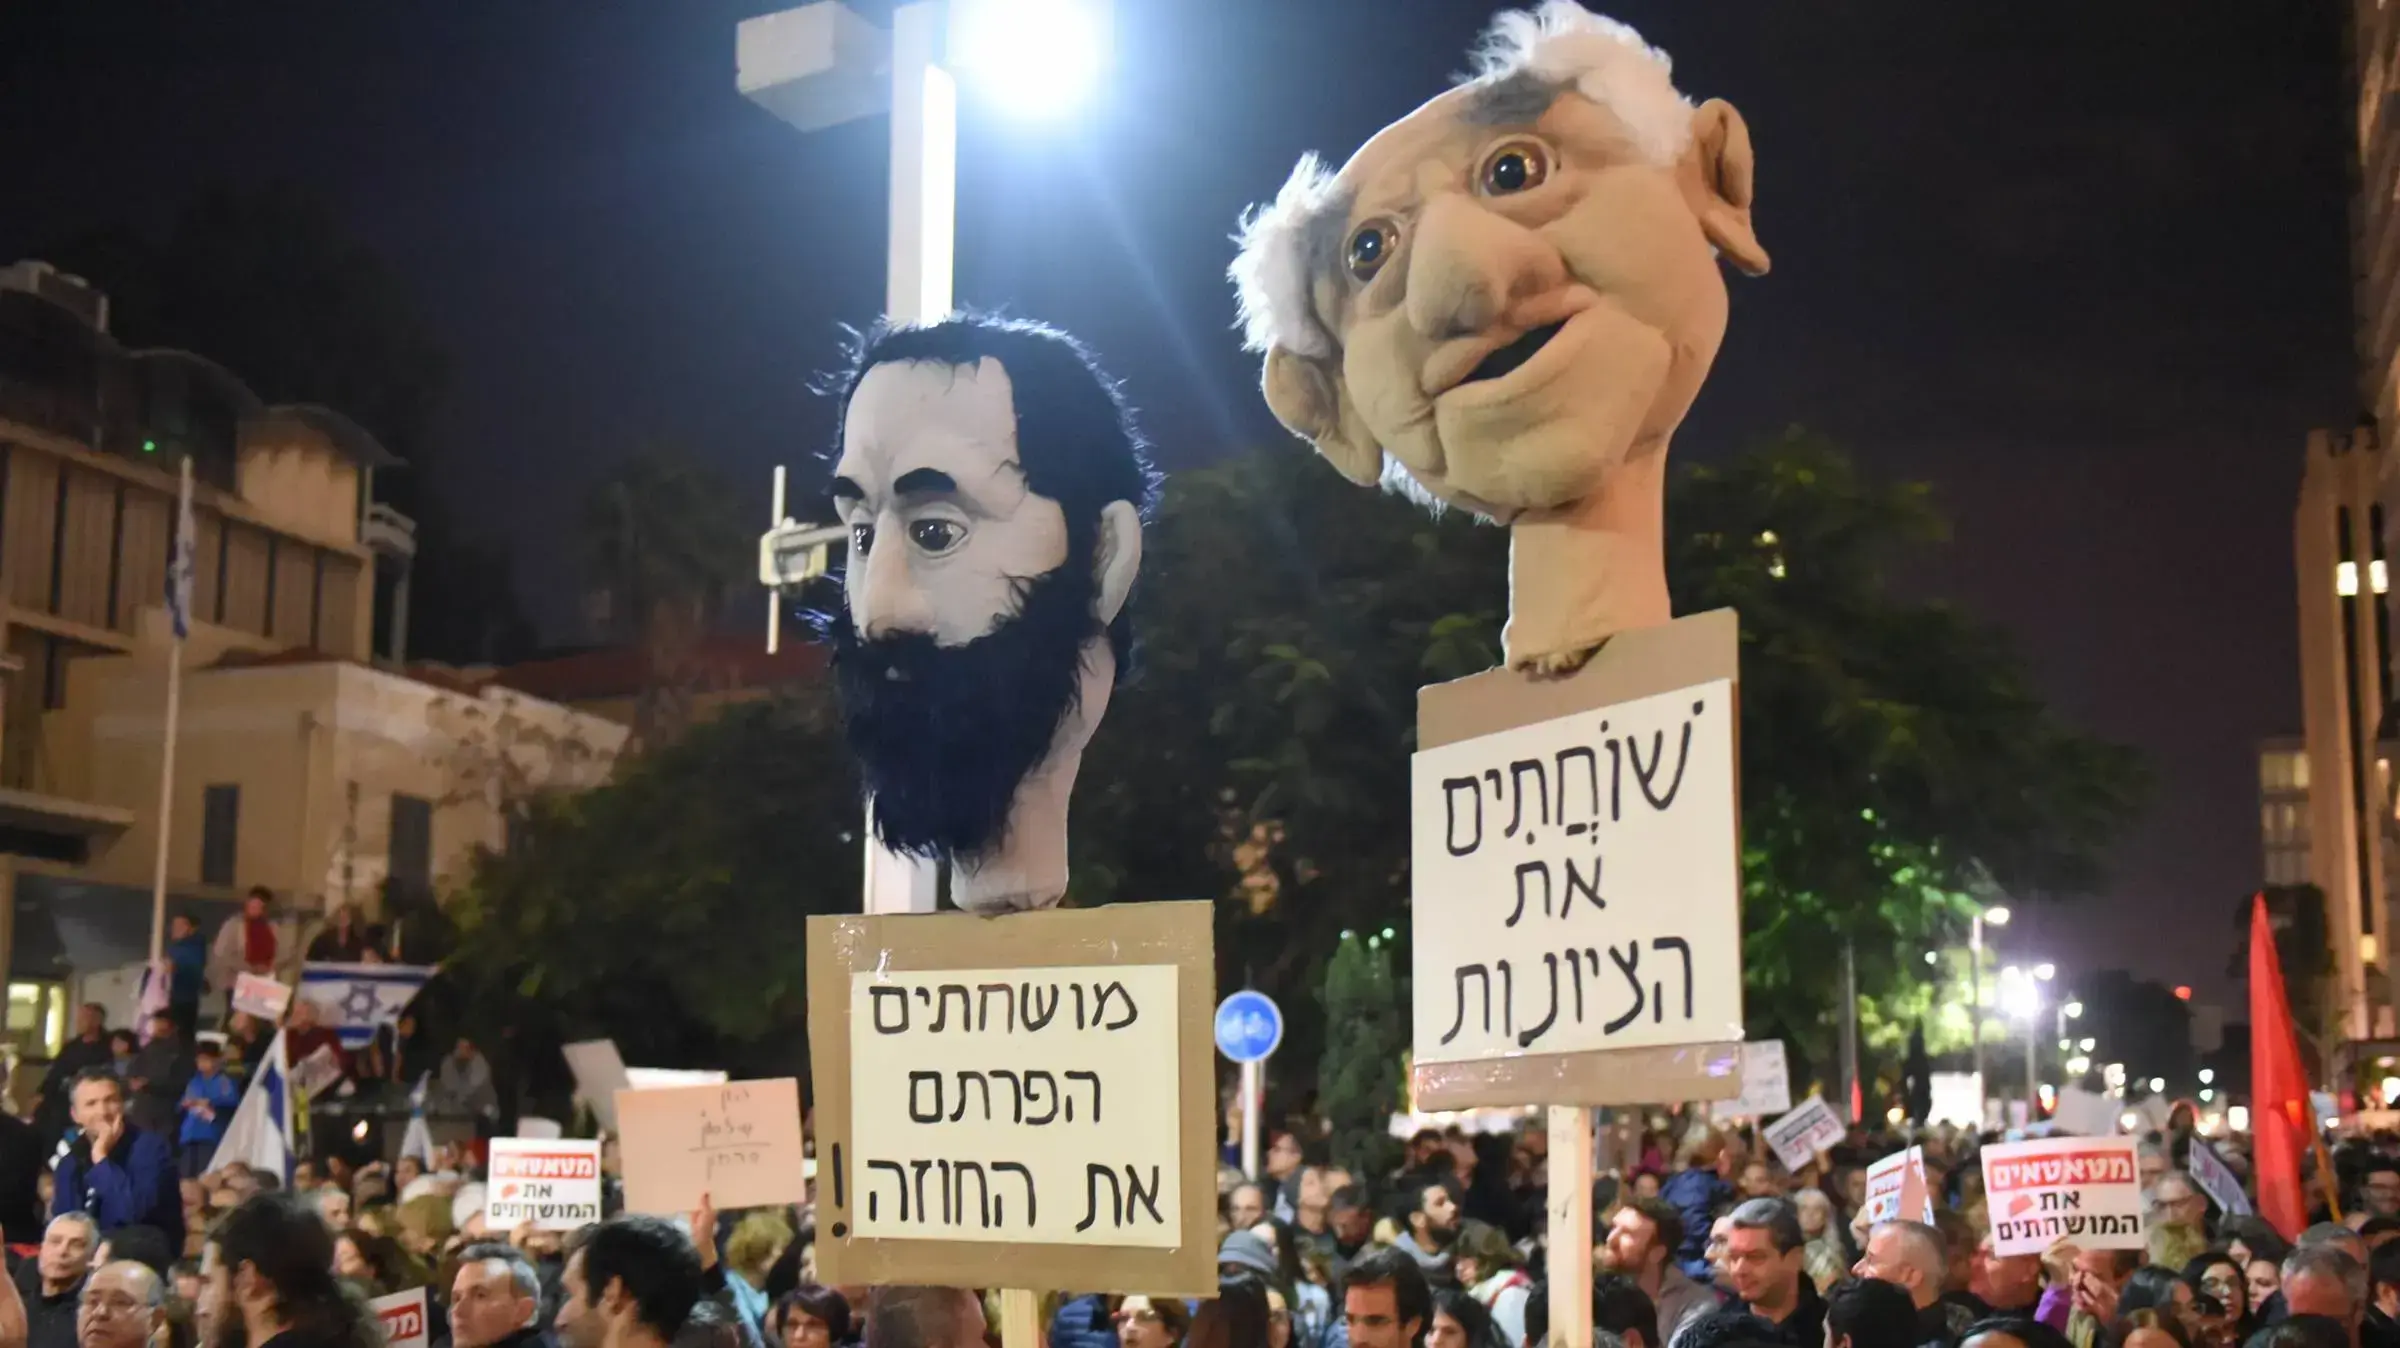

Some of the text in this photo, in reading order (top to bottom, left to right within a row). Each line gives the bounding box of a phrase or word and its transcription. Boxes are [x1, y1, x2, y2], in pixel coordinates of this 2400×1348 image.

[1505, 855, 1607, 928] את
[868, 981, 1139, 1034] מושחתים
[1440, 935, 1694, 1048] הציונות
[908, 1070, 1102, 1125] הפרתם
[523, 1183, 553, 1198] את
[1992, 1156, 2132, 1188] מטאטאים
[491, 1202, 596, 1219] המושחתים
[1075, 1162, 1165, 1233] את
[2039, 1190, 2081, 1212] את
[1997, 1214, 2139, 1241] המושחתים
